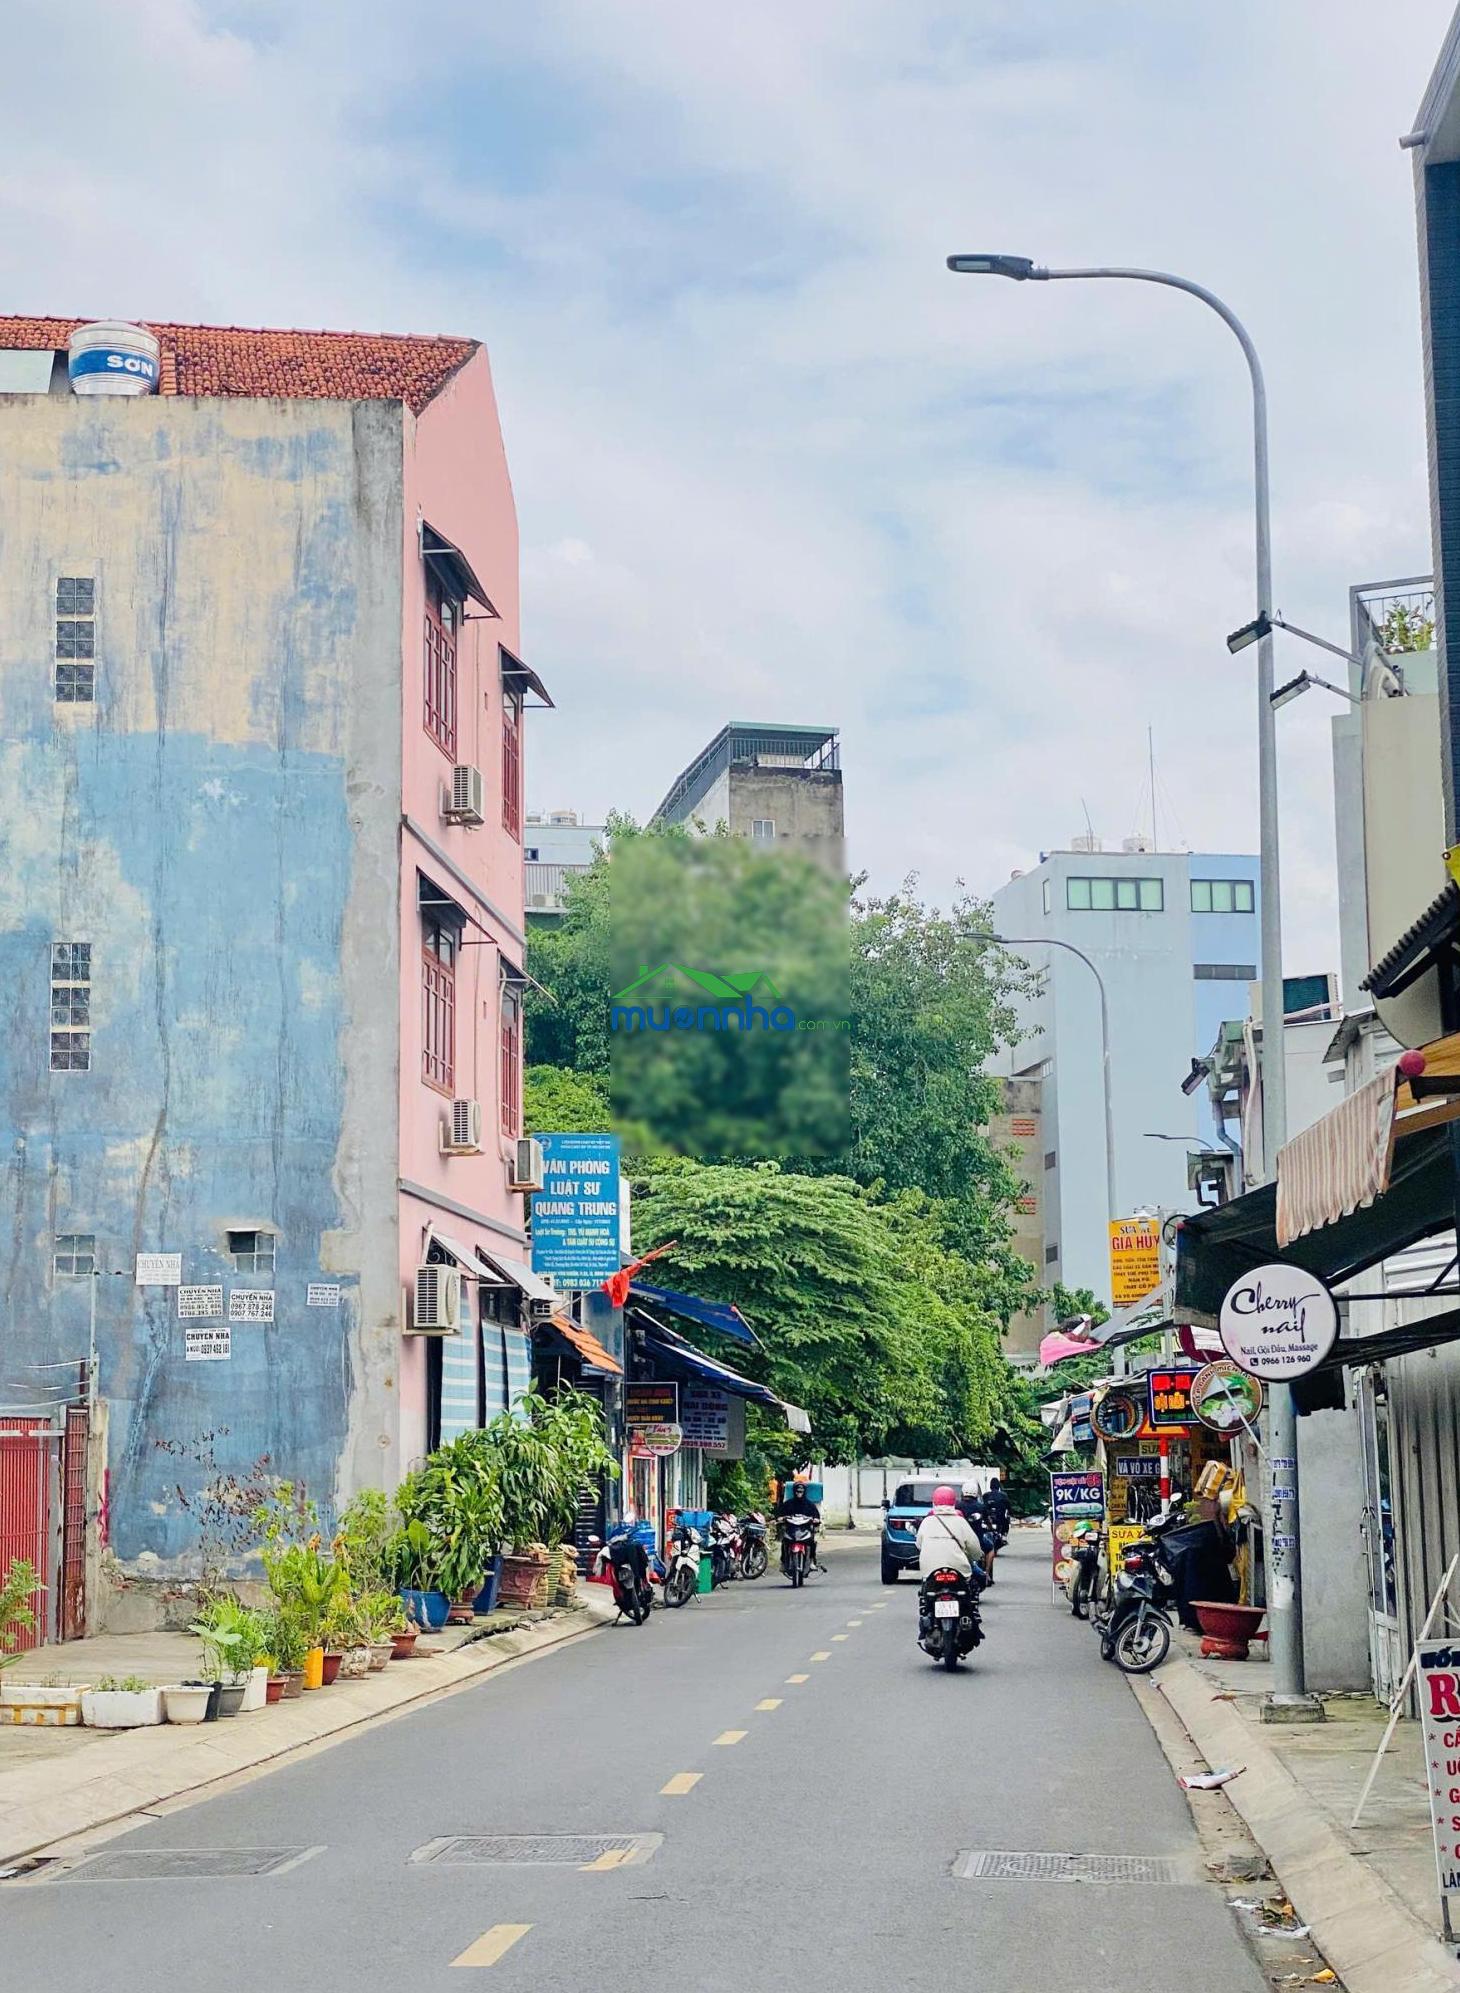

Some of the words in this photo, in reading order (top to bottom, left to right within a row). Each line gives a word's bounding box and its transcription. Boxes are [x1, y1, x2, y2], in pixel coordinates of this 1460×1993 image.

[569, 1157, 610, 1174] PHÒNG
[550, 1179, 579, 1197] LUẬT
[534, 1201, 574, 1217] QUANG
[577, 1201, 617, 1216] TRUNG
[1112, 1236, 1133, 1250] GIA
[1136, 1234, 1160, 1250] HUY
[1230, 1280, 1321, 1319] Cherry
[1261, 1307, 1306, 1343] nail
[1288, 1343, 1319, 1353] Massage
[1261, 1357, 1280, 1365] 0966
[1282, 1356, 1296, 1364] 126
[1297, 1354, 1311, 1363] 960
[1119, 1460, 1129, 1474] VÁ
[1142, 1462, 1153, 1474] XE
[1056, 1487, 1101, 1502] 9K/KG
